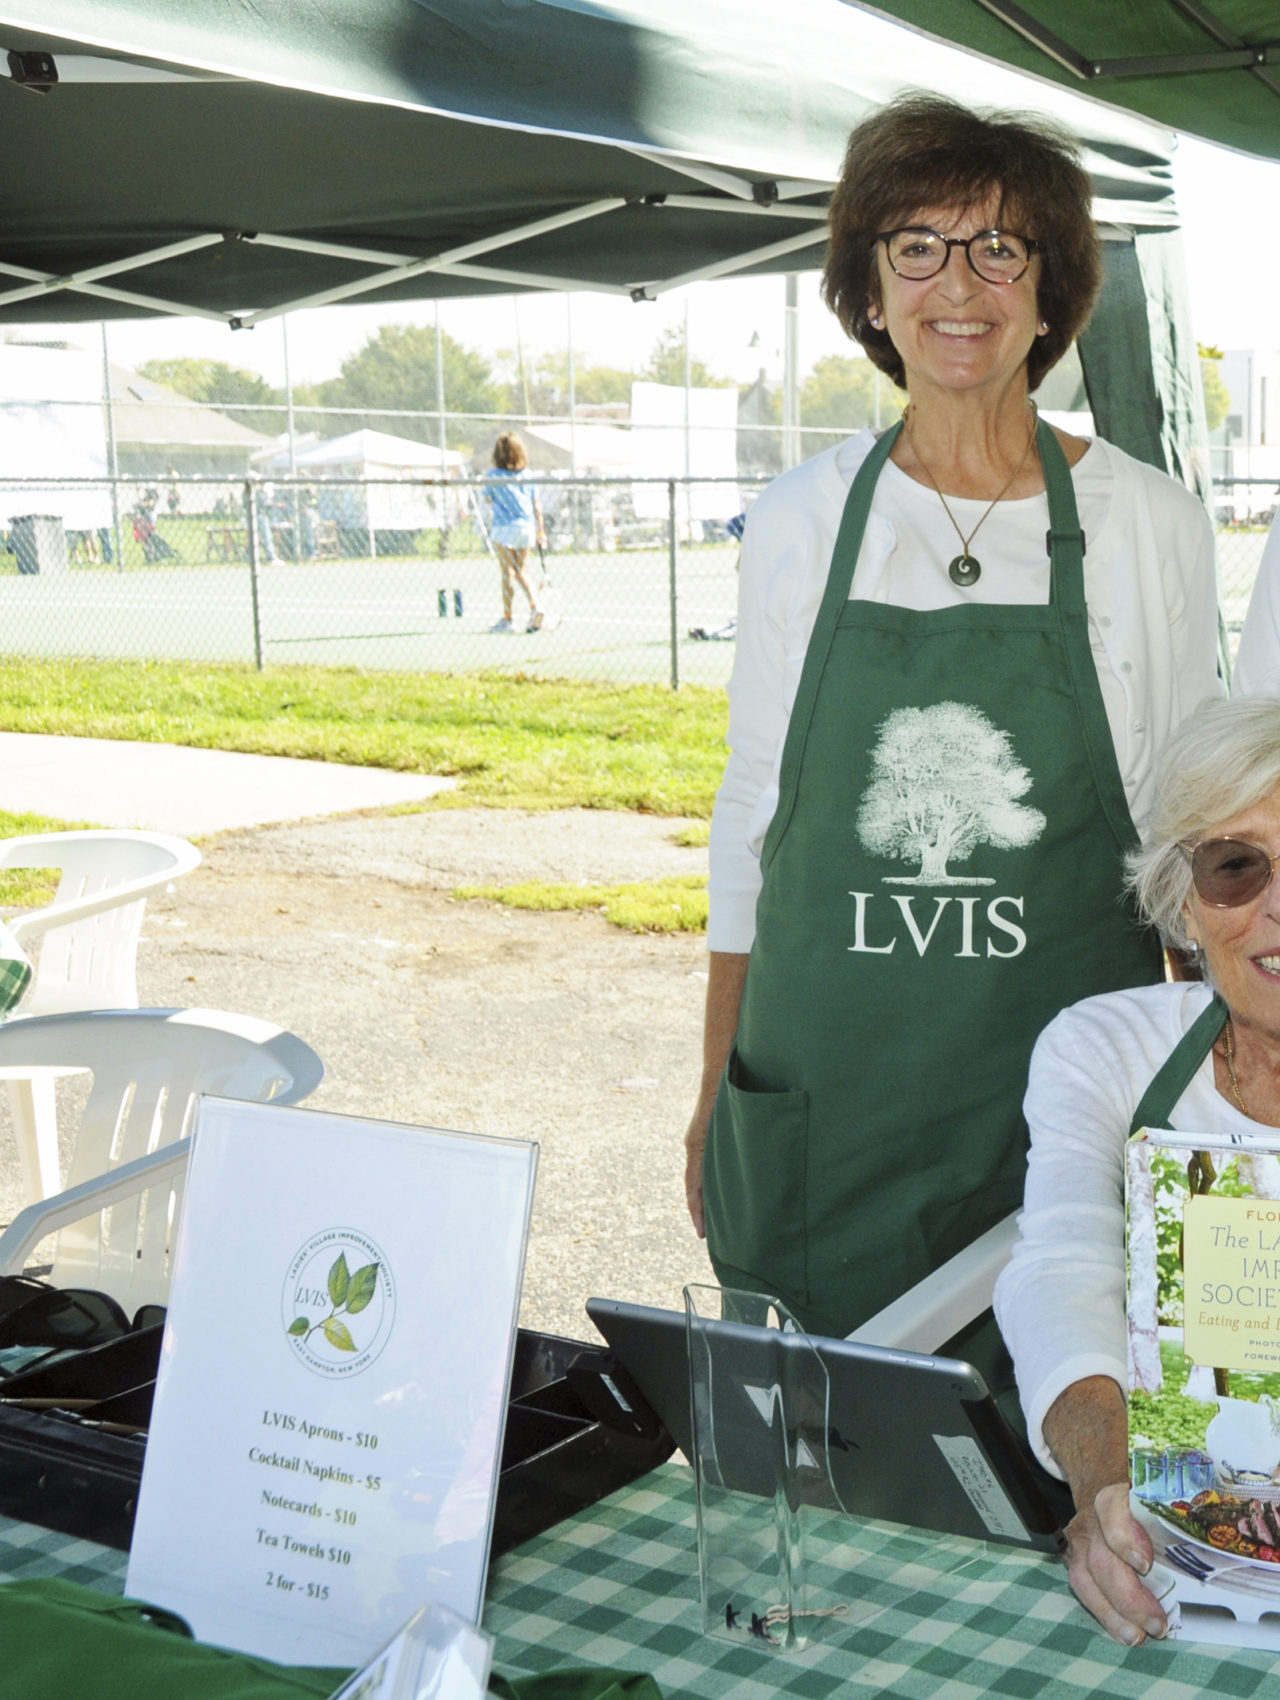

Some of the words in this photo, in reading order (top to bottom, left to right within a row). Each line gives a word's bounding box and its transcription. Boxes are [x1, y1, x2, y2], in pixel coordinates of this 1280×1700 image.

[848, 891, 1027, 959] LVIS
[1210, 1225, 1249, 1249] The
[309, 1233, 336, 1250] VILLAGE
[338, 1232, 382, 1261] IMPROVEMENT
[380, 1262, 393, 1299] SOCIETY
[295, 1287, 328, 1308] LVIS
[1199, 1311, 1241, 1332] Eating
[1244, 1312, 1271, 1331] and
[338, 1365, 353, 1374] NEW
[262, 1410, 297, 1432] LVIS
[298, 1419, 344, 1442] Aprons
[355, 1432, 378, 1449] $10
[249, 1447, 300, 1472] Cocktail
[303, 1460, 354, 1484] Napkins
[366, 1475, 381, 1490] $5
[261, 1490, 323, 1518] Notecards
[334, 1508, 357, 1526] $10
[256, 1528, 279, 1547] Tea
[282, 1536, 325, 1559] Towels
[328, 1547, 351, 1565] $10
[265, 1571, 274, 1587] 2
[276, 1574, 296, 1592] for
[307, 1582, 331, 1600] $15
